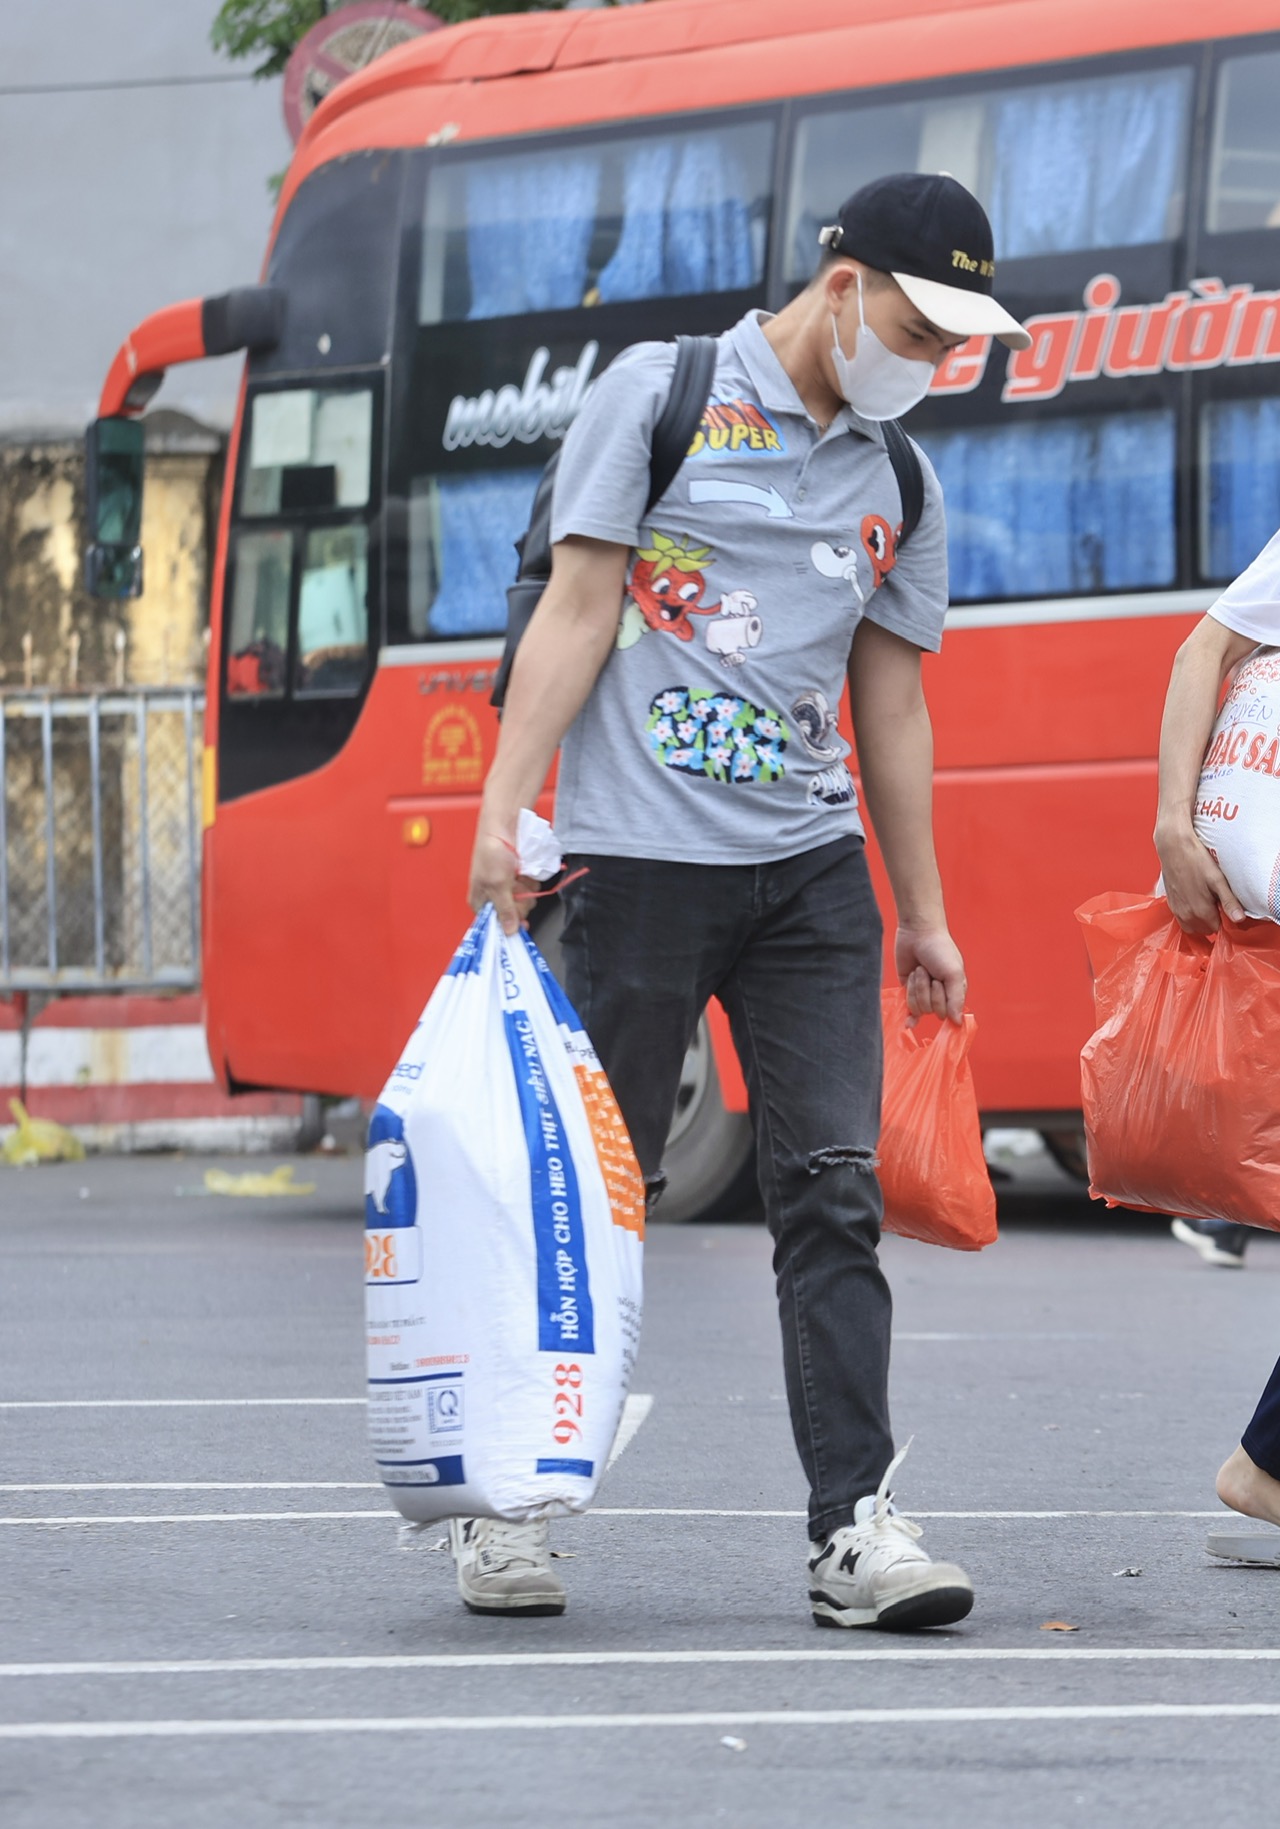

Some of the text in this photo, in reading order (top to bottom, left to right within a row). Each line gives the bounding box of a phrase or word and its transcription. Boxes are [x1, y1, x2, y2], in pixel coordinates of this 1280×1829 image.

[951, 250, 978, 273] The
[552, 1202, 571, 1245] CHO
[553, 1251, 579, 1291] HỢP
[550, 1297, 579, 1341] HỖN
[553, 1363, 583, 1444] 928
